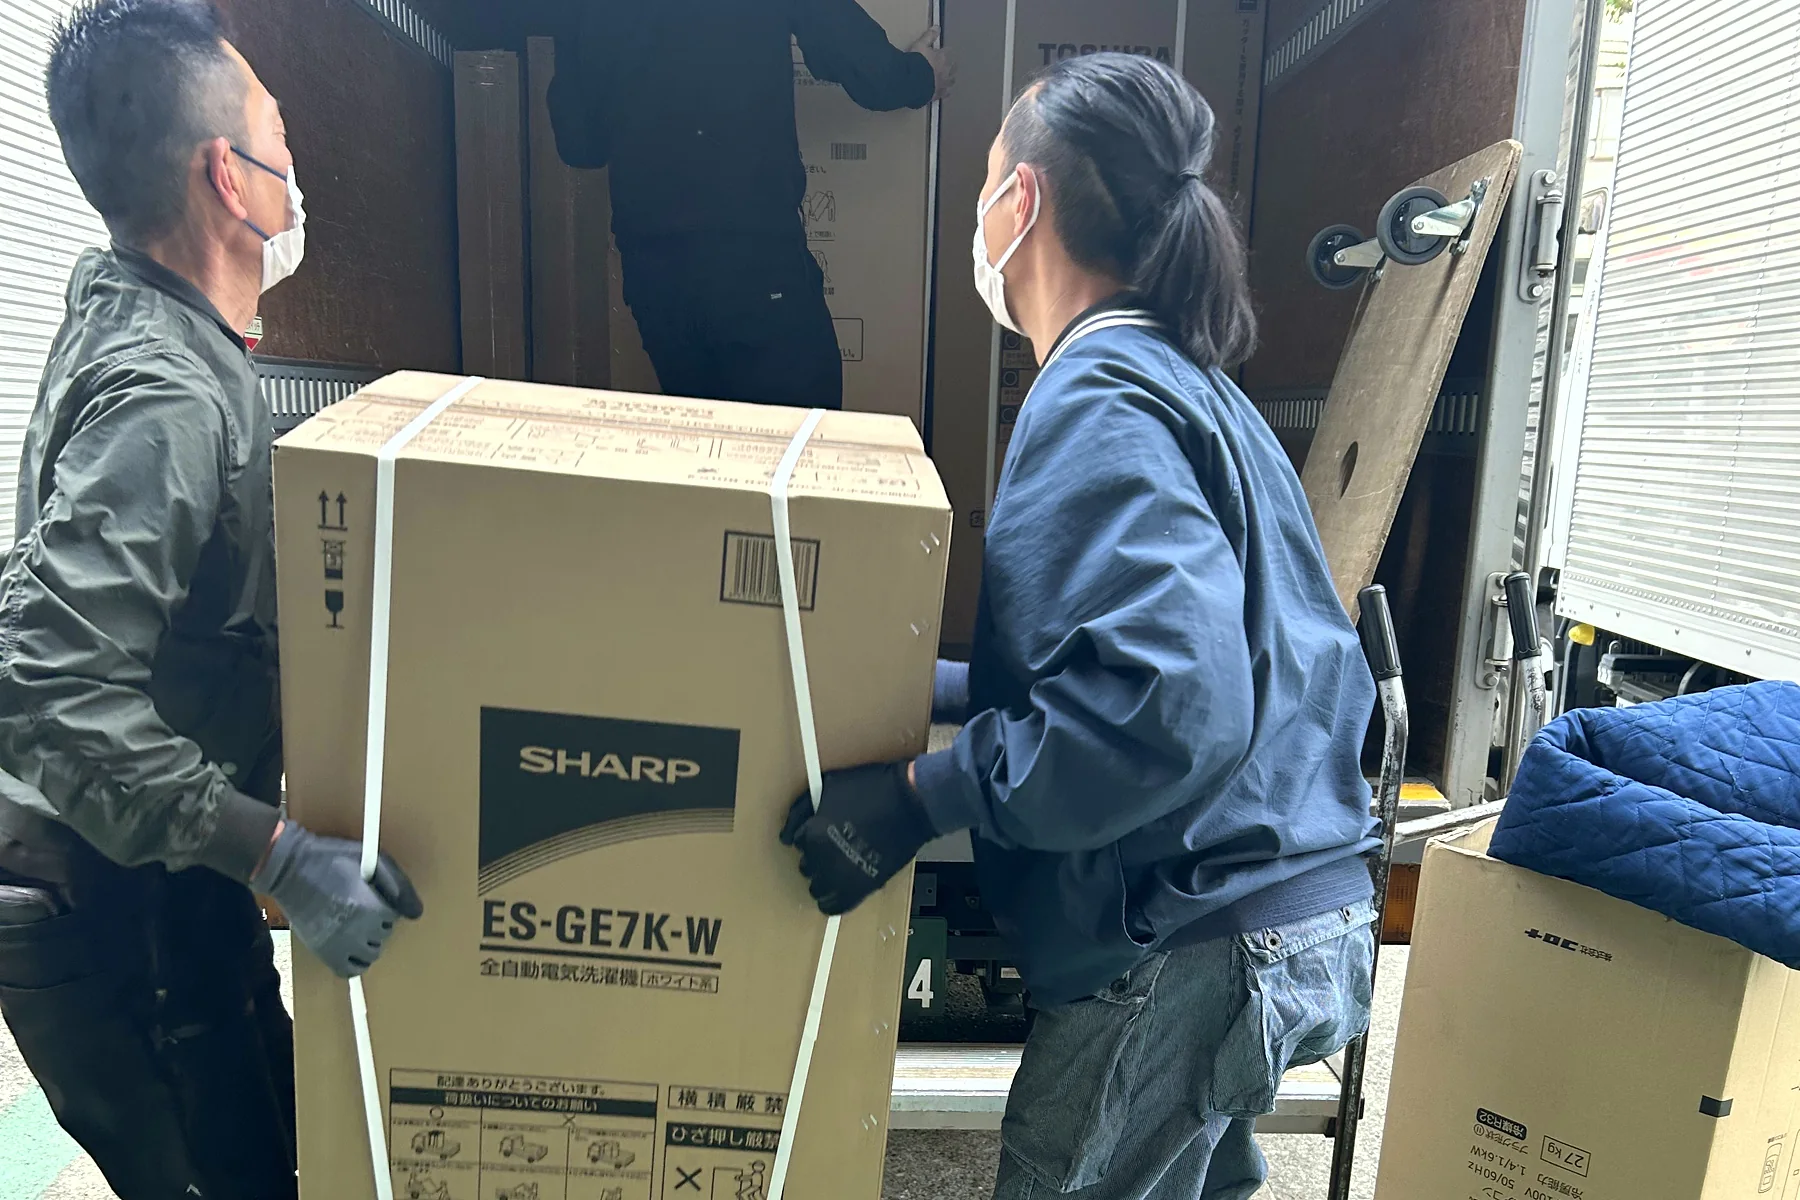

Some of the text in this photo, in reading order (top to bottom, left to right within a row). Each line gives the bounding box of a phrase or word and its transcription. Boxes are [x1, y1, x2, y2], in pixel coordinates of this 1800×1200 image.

[519, 745, 702, 785] SHARP
[482, 899, 722, 956] ES-GE7K-W
[480, 957, 714, 991] 全自動電気洗濯機 ホワイト系
[907, 958, 934, 1008] 4
[1470, 1145, 1527, 1176] 1.4/1.6kW
